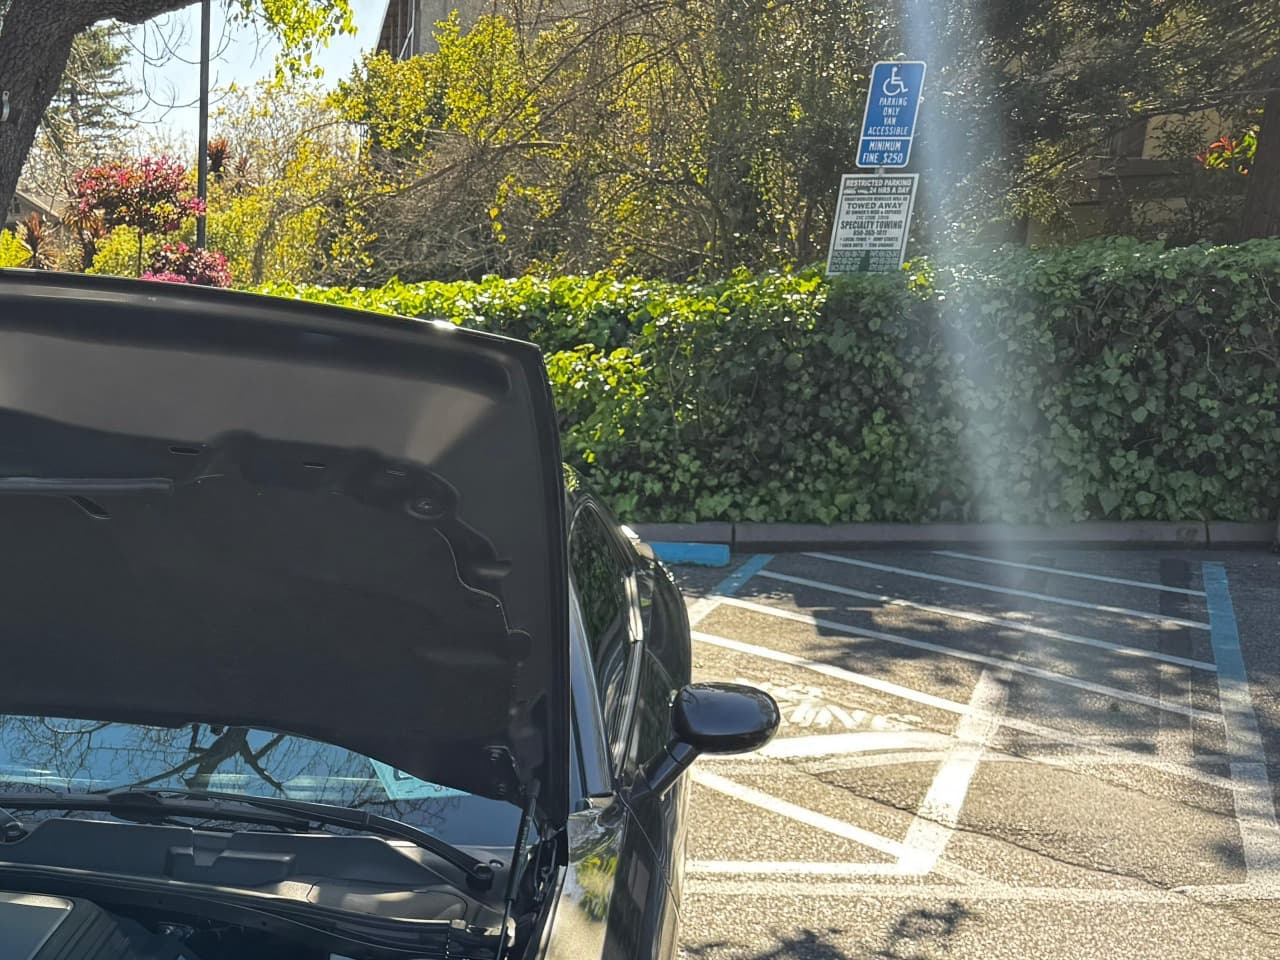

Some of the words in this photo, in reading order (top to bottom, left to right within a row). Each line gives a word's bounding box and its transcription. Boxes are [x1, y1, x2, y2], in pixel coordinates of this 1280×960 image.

[879, 97, 908, 106] PARKING
[882, 107, 900, 116] ONLY
[884, 117, 897, 126] VAN
[867, 126, 909, 136] ACCESSIBLE
[868, 141, 902, 151] MINIMUM
[862, 153, 880, 164] FINE
[883, 153, 904, 163] $250
[845, 179, 884, 187] RESTRICTED
[840, 220, 875, 229] SPECIALTY
[876, 220, 903, 229] TOWING
